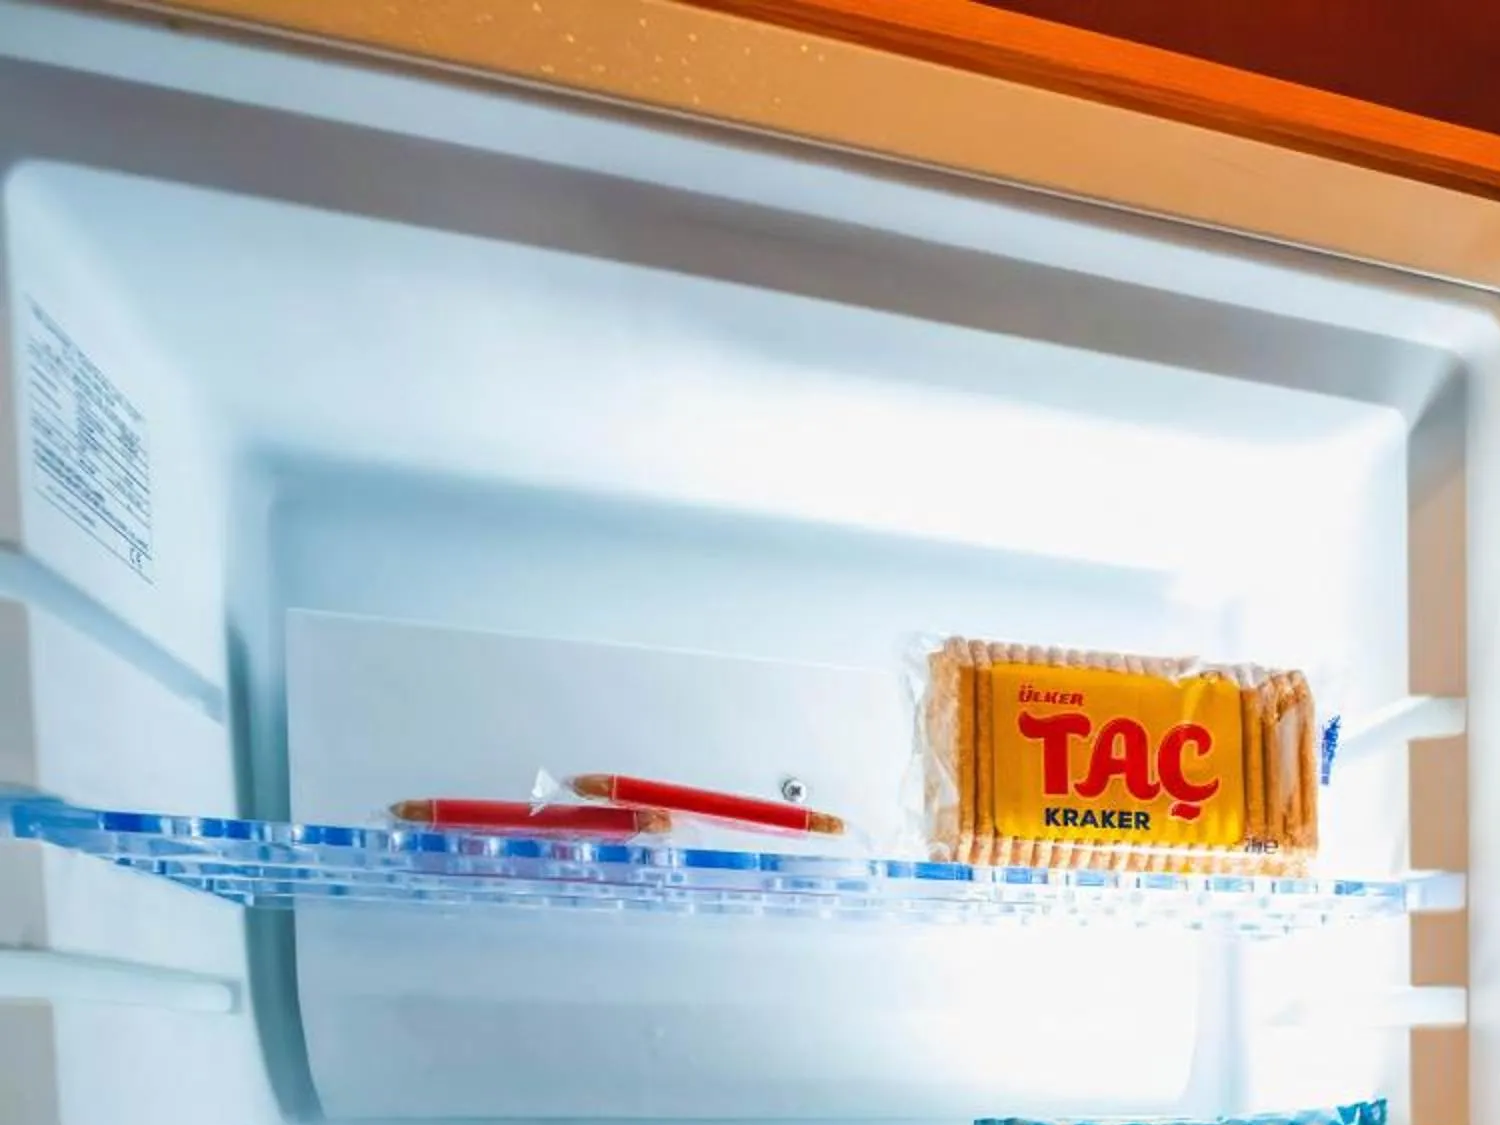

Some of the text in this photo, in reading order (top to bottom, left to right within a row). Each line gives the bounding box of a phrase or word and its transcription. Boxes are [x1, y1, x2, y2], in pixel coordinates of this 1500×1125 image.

[1018, 683, 1085, 707] ÜLKER
[1018, 710, 1220, 821] TAÇ
[1044, 807, 1151, 831] KRAKER
